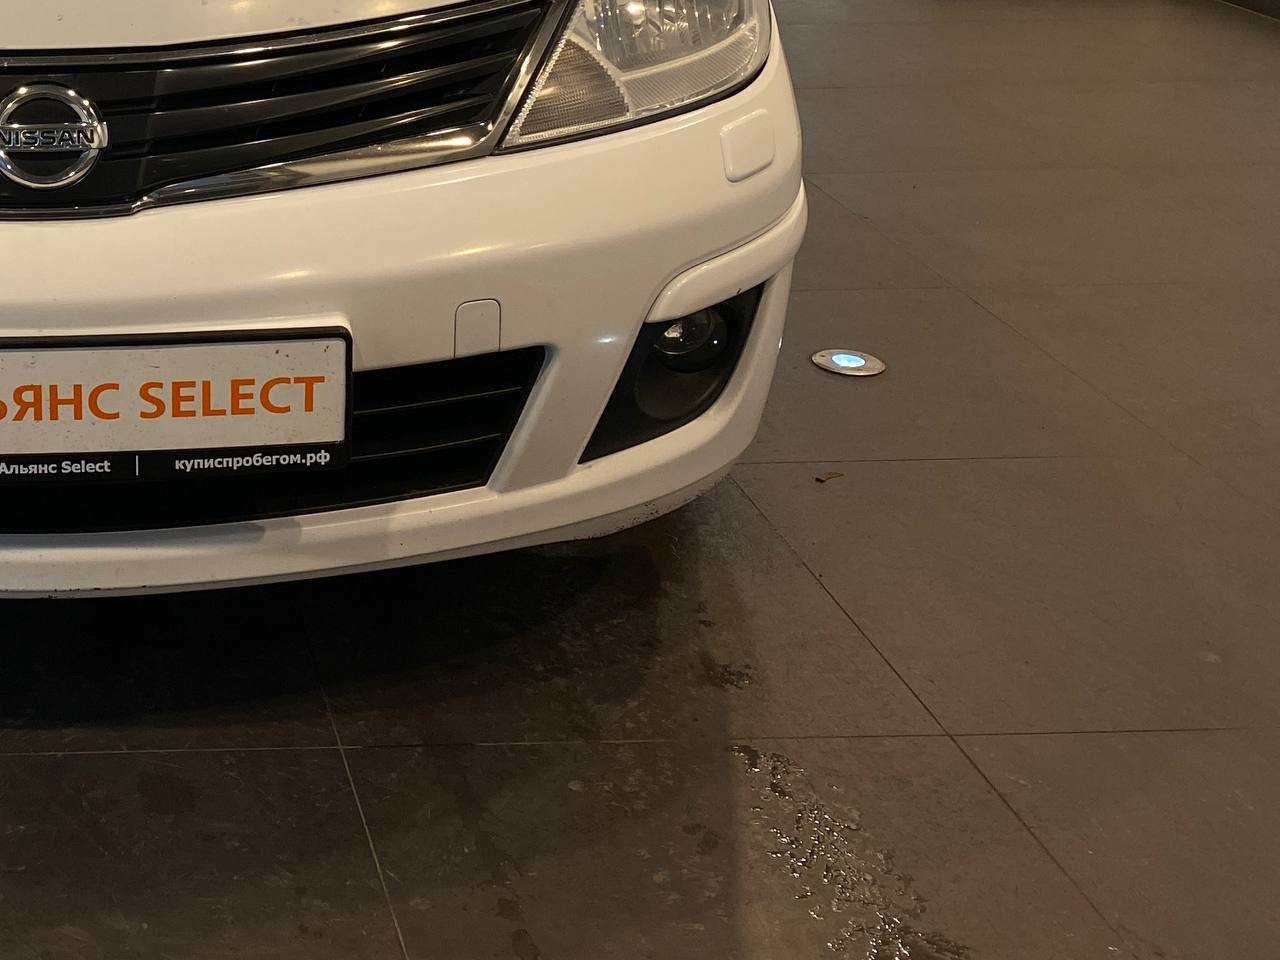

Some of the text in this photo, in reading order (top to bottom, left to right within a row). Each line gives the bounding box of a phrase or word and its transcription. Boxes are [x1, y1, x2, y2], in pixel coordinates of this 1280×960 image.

[138, 375, 326, 420] SELECT
[61, 459, 111, 473] Select
[175, 449, 331, 472] куписпробегом.рф
